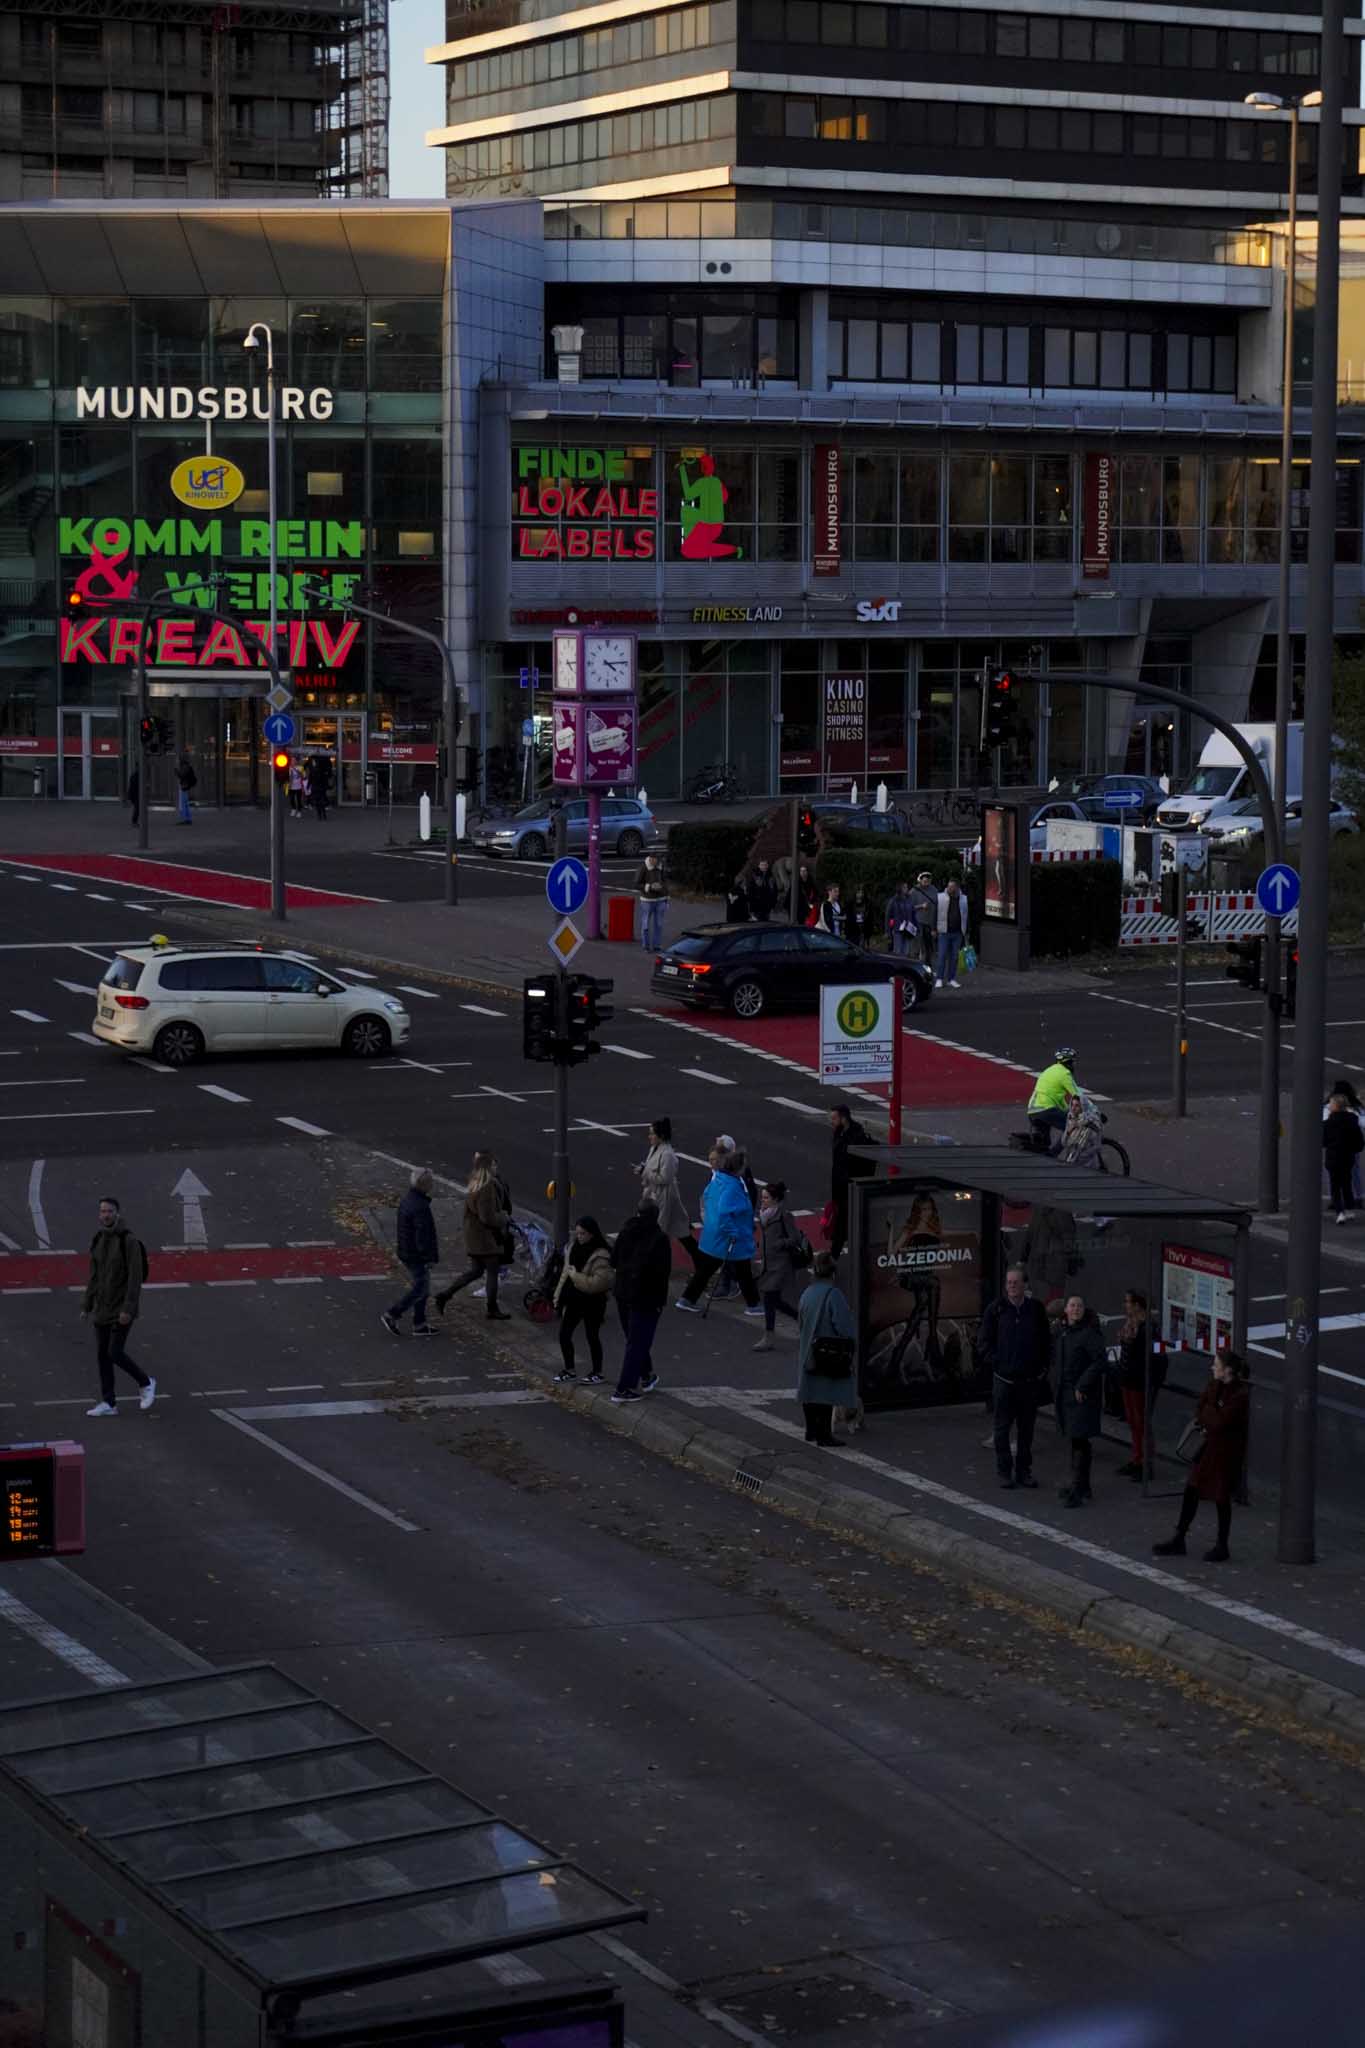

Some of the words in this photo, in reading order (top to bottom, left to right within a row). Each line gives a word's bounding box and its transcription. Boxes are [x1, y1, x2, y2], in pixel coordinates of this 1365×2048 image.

[76, 386, 334, 419] MUNDSBURG
[518, 447, 625, 480] FINDE
[518, 484, 659, 519] LOKALE
[827, 449, 839, 552] MUNDSBURG
[1097, 457, 1110, 555] MUNDSBURG
[58, 517, 223, 557] KOMM
[239, 519, 363, 558] REIN
[518, 527, 657, 560] LABELS
[692, 607, 784, 624] FITNESSLAND
[59, 616, 362, 669] KREATIV
[826, 680, 864, 700] KINO
[826, 701, 864, 713] CASINO
[826, 715, 864, 726] SHOPPING
[826, 728, 864, 741] FITNESS
[849, 1001, 868, 1028] H
[842, 1042, 881, 1053] Mundsburg
[877, 1248, 973, 1268] CALZEDONIA
